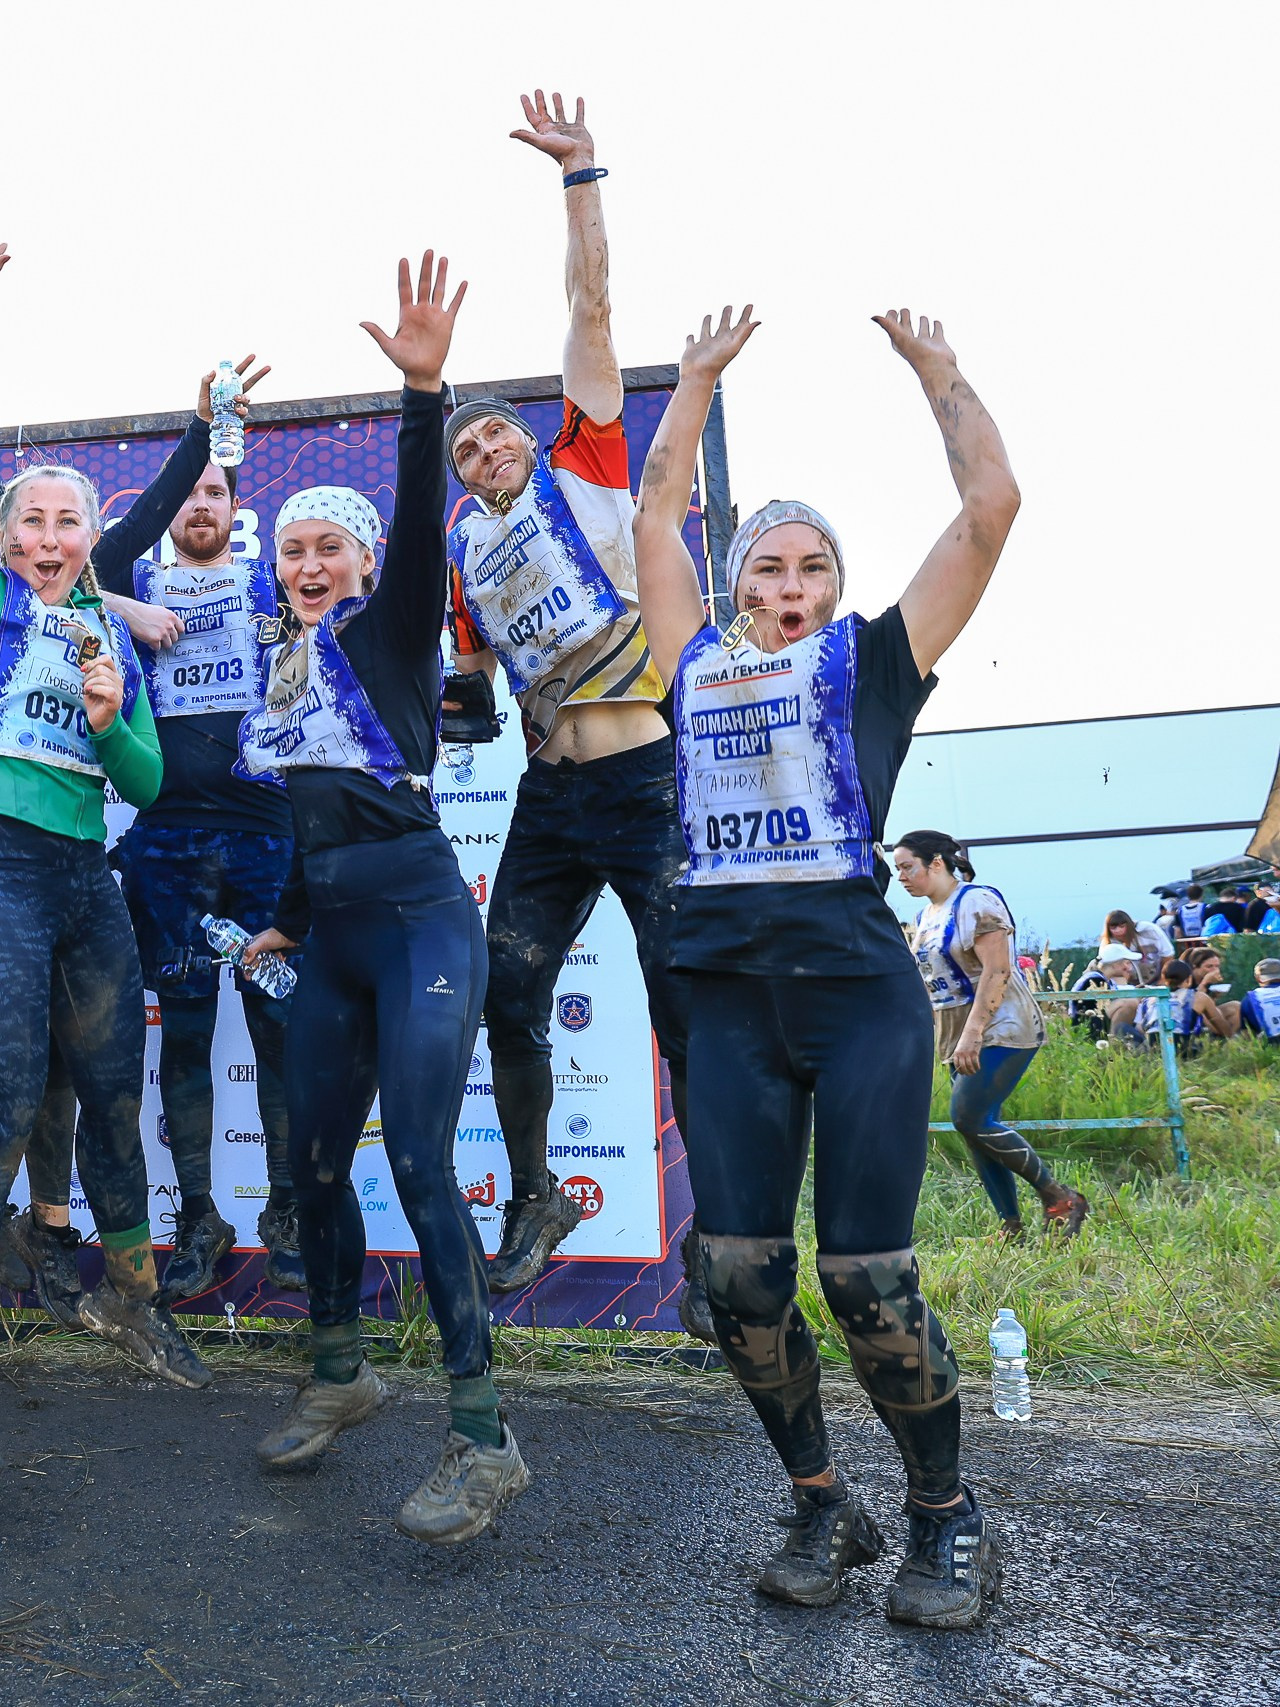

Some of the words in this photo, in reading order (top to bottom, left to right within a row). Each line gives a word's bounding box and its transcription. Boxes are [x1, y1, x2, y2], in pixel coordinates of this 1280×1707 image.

[477, 515, 539, 584] КОМАНДНЫЙ
[494, 552, 526, 587] СТАРТ
[165, 585, 197, 595] ГОНКА
[199, 578, 236, 593] ГЕРОЕВ
[171, 594, 241, 620] ОМАНДНЫЙ
[186, 614, 221, 633] СТАРТ
[507, 586, 572, 647] 03710
[173, 657, 244, 687] 03703
[694, 670, 728, 687] ГОНКА
[732, 658, 793, 679] ГЕРОЕВ
[191, 691, 248, 703] ГАЗПРОМБАНК
[24, 690, 87, 740] 0370
[692, 695, 799, 737] КОМАНДНЫЙ
[716, 731, 767, 758] СТАРТ
[434, 790, 508, 804] ЗПРОМБАНК
[706, 806, 812, 851] 03709
[450, 833, 501, 845] ANK
[729, 849, 820, 865] ГАЗПРОМБАНК
[565, 953, 599, 966] КУЛЕС
[426, 986, 454, 995] DEMIX
[552, 1074, 609, 1085] ITTORIO
[456, 1127, 505, 1142] VITRO
[547, 1145, 626, 1158] ЗПРОМБАНК
[234, 1186, 270, 1195] RAVE
[563, 1184, 598, 1198] MY
[360, 1201, 389, 1211] LOW
